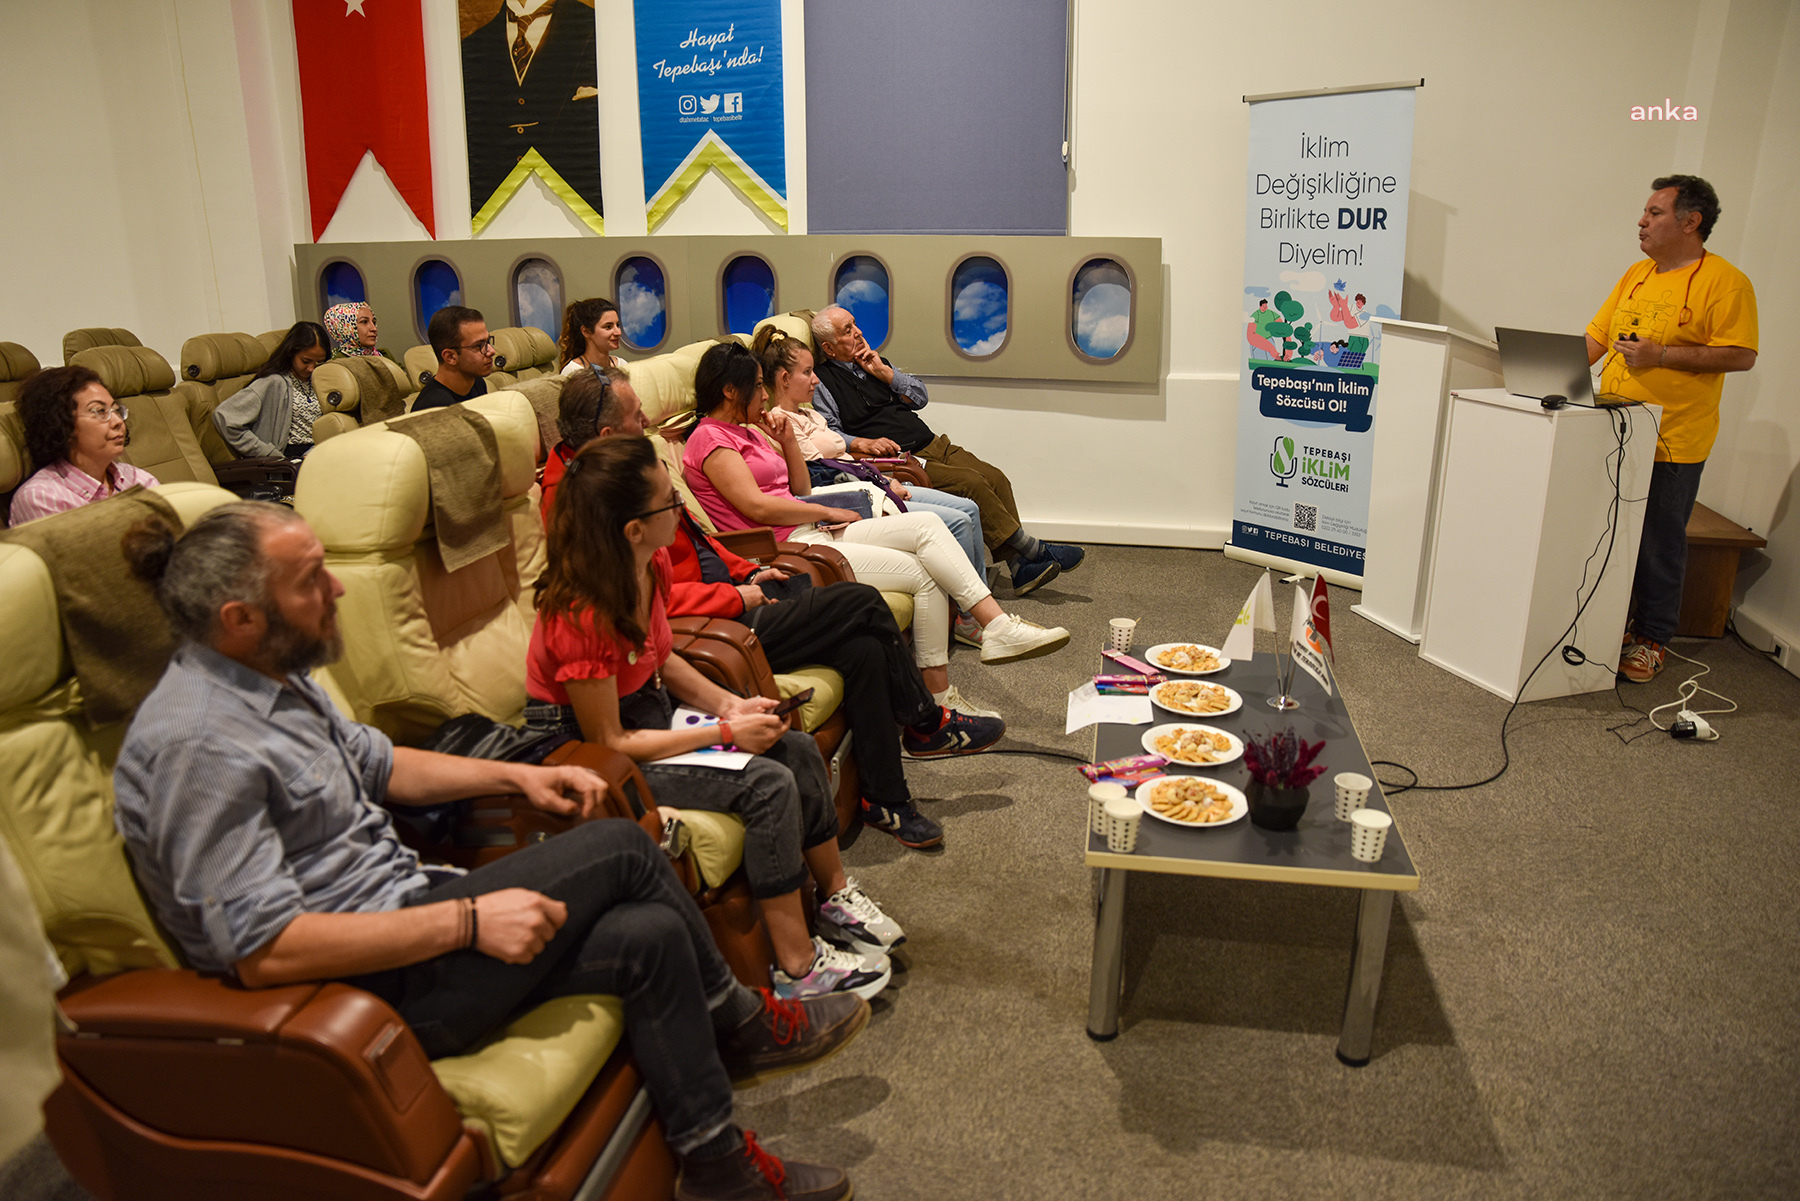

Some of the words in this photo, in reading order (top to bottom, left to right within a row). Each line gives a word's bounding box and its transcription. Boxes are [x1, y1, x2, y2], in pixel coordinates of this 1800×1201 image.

[679, 23, 735, 52] Hayat
[652, 46, 764, 83] Tepebaşı'nda!
[1300, 132, 1349, 159] İklim
[1256, 170, 1397, 201] Değişikliğine
[1260, 207, 1330, 229] Birlikte
[1337, 207, 1388, 230] DUR
[1279, 242, 1364, 269] Diyelim!
[1338, 377, 1369, 396] İklim
[1276, 393, 1326, 411] Sözcüsü
[1328, 399, 1348, 413] Ol!
[1303, 445, 1351, 463] TEPEBAŞI
